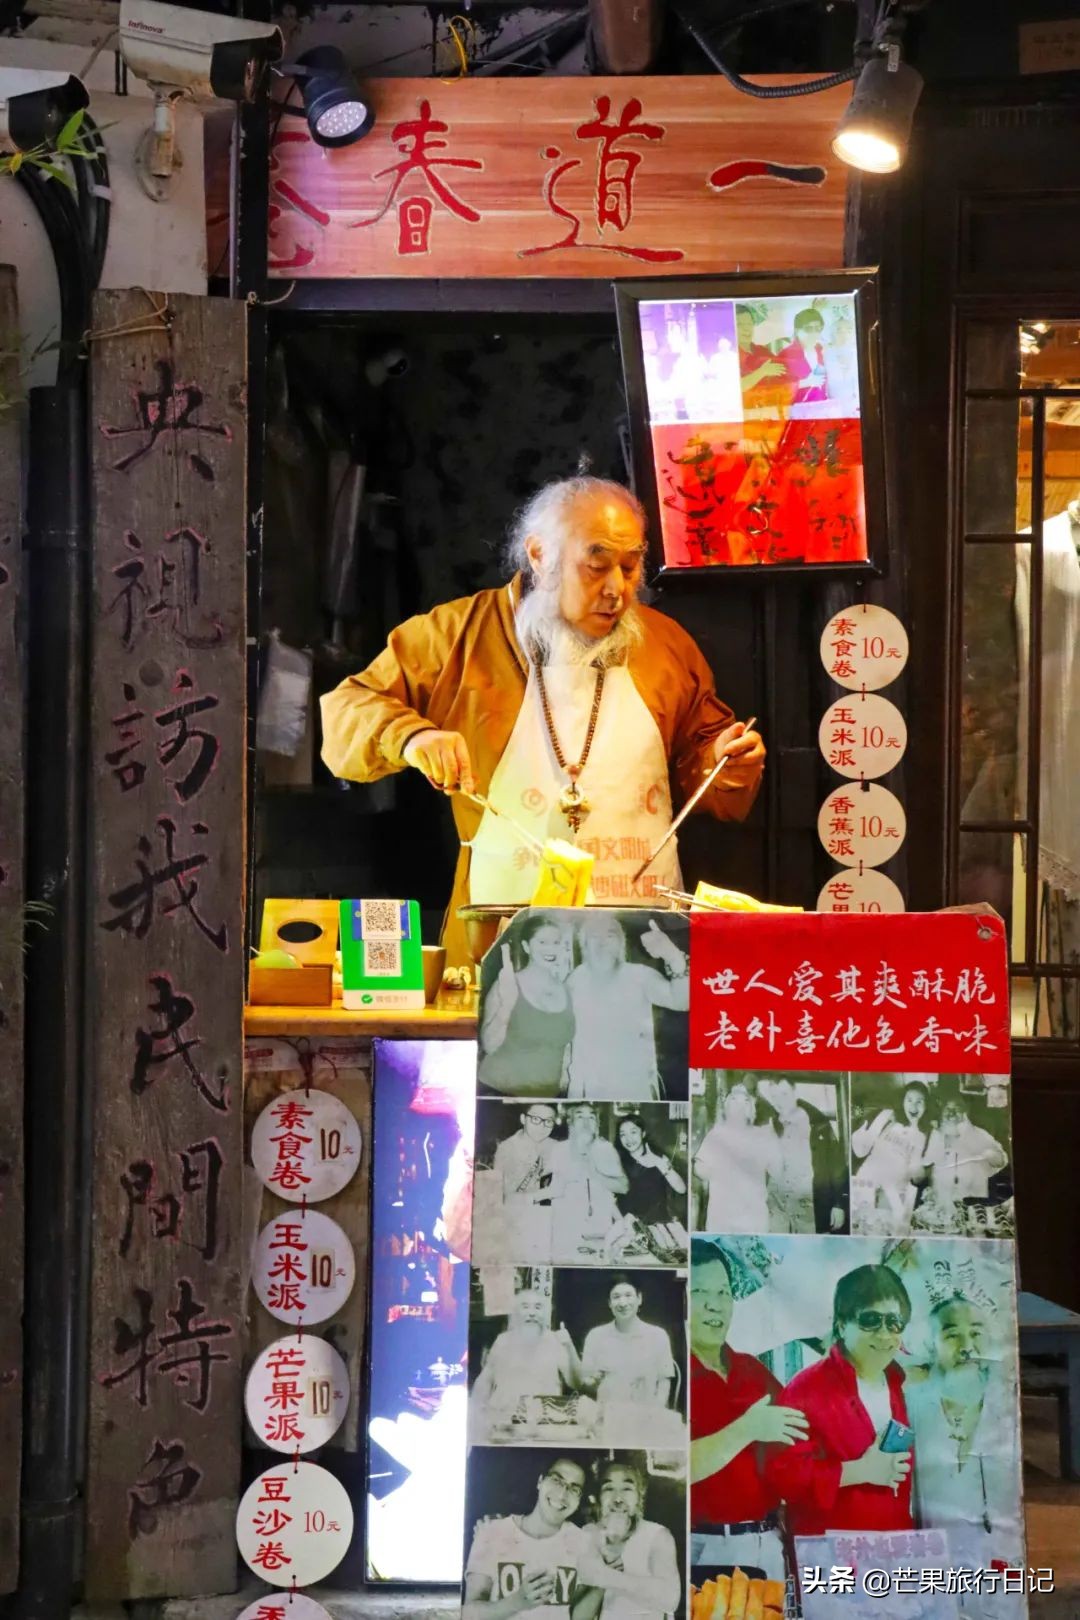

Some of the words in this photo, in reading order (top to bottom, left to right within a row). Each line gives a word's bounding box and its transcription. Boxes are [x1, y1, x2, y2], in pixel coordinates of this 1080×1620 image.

[830, 618, 857, 678] 素食卷
[829, 708, 857, 767] 玉米派
[828, 796, 855, 856] 香蕉派
[702, 961, 997, 1009] 世人爱其爽酥脆
[703, 1010, 999, 1056] 老外喜他色香味
[268, 1102, 313, 1190] 素食卷
[267, 1223, 308, 1311] 玉米派
[264, 1348, 307, 1442] 芒果派
[252, 1477, 294, 1571] 豆沙卷
